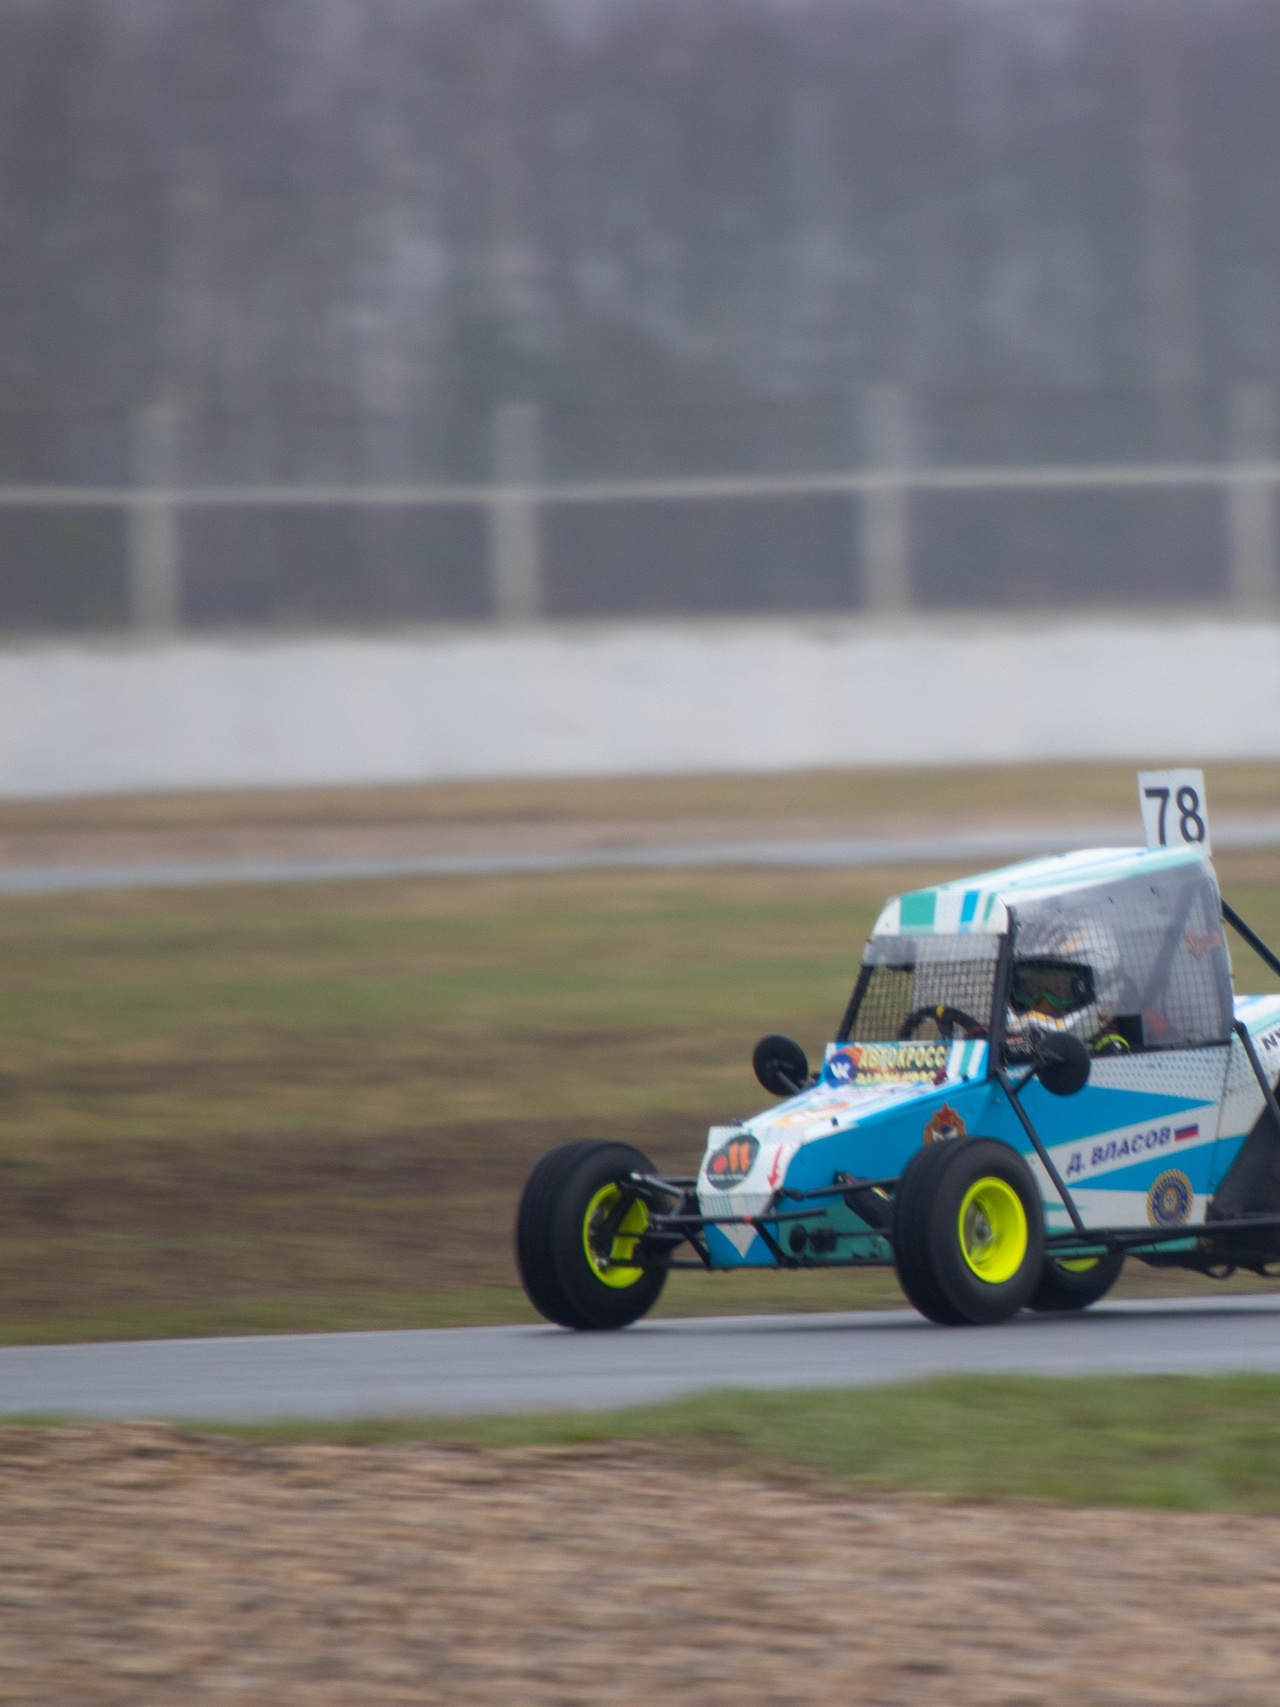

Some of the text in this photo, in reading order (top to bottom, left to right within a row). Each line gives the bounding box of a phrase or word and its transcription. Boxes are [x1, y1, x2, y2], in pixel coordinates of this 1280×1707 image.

[1144, 785, 1206, 846] 78
[857, 1044, 947, 1070] АВТОКРОСС
[1090, 1126, 1172, 1167] ВЛАСОВ
